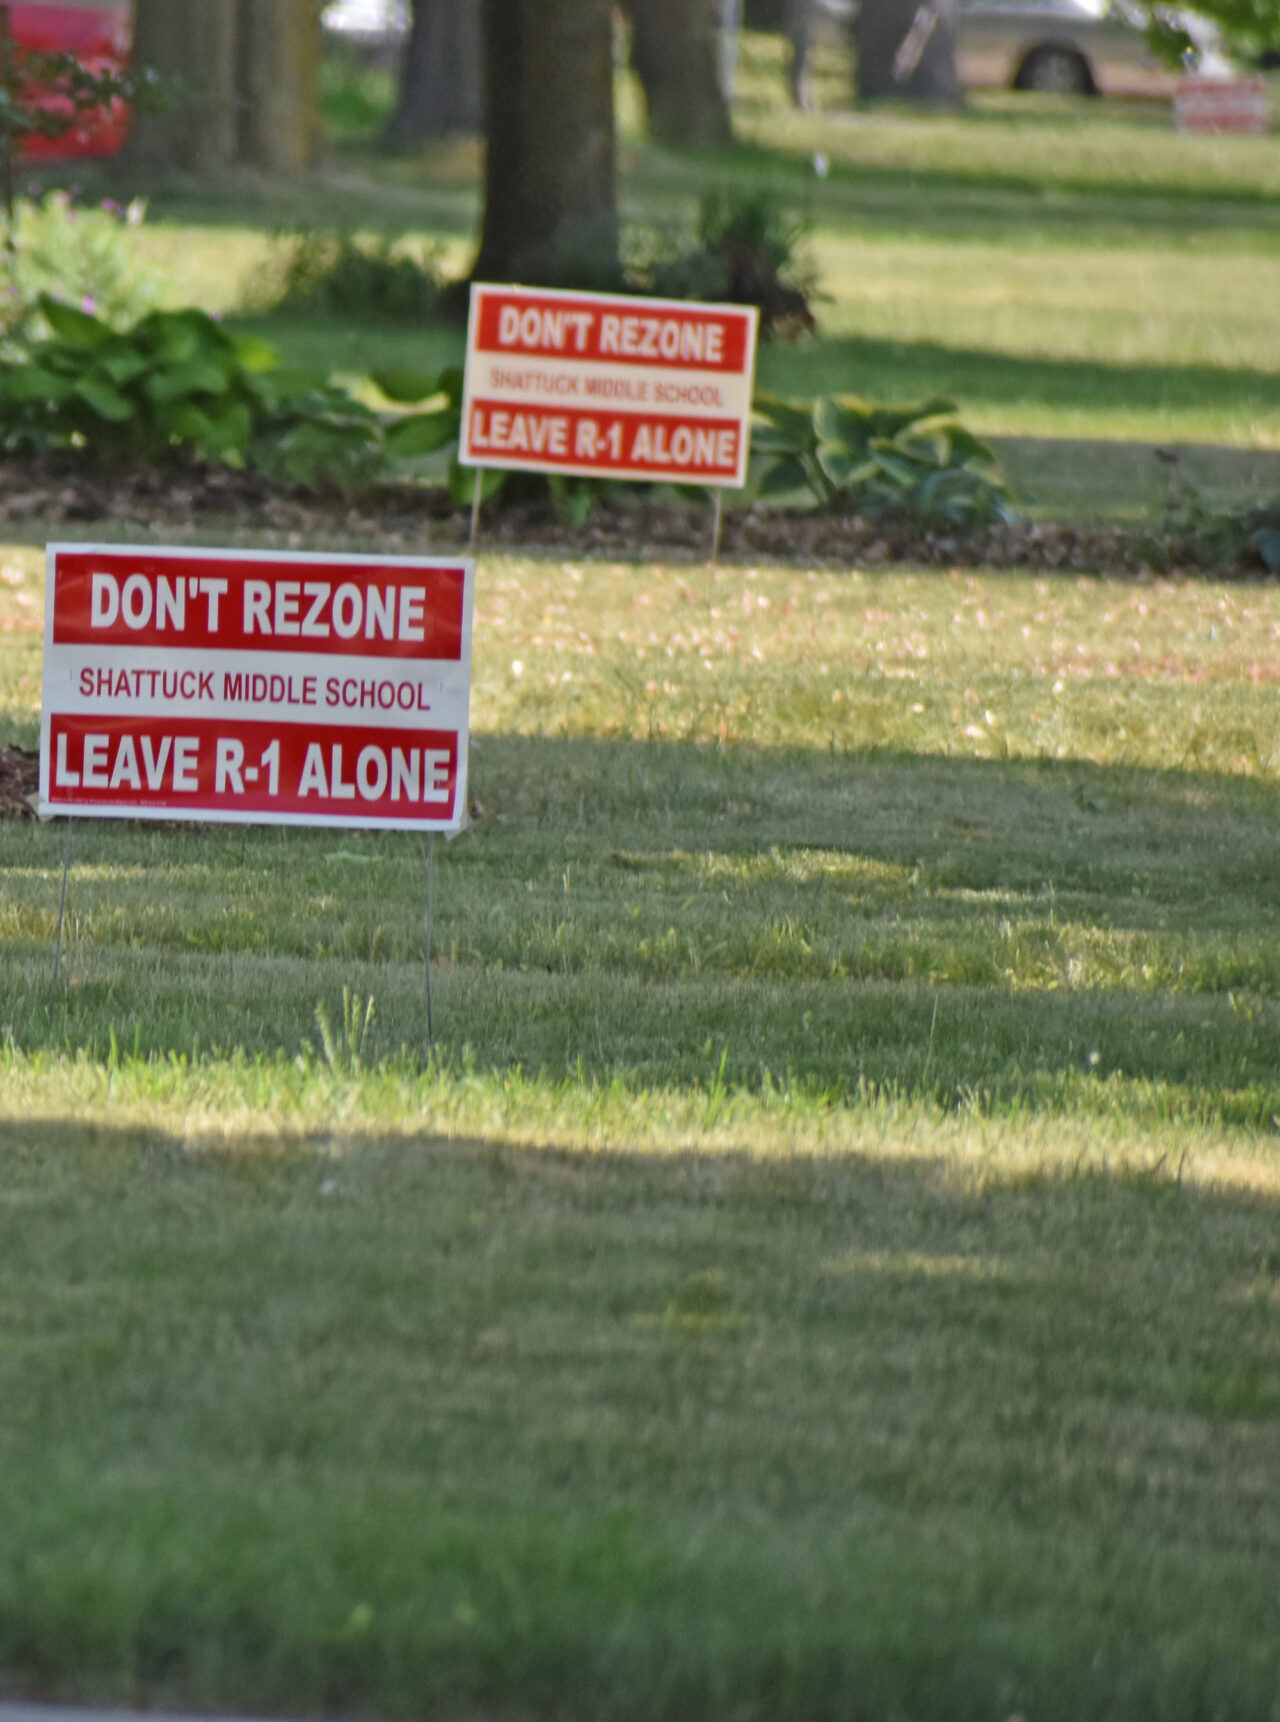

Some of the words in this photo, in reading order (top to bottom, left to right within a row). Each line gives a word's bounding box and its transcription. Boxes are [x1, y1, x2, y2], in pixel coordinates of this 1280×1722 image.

[498, 305, 593, 351] DON'T
[600, 315, 725, 362] REZONE
[489, 367, 578, 394] SHATTUCK
[584, 377, 647, 401] MIDDLE
[654, 383, 723, 407] SCHOOL
[472, 410, 568, 454] LEAVE
[576, 419, 622, 459] R-1
[630, 424, 735, 467] ALONE
[91, 573, 228, 632] DON'T
[243, 579, 426, 642] REZONE
[80, 668, 214, 699] SHATTUCK
[224, 673, 317, 704] MIDDLE
[326, 678, 431, 711] SCHOOL
[56, 732, 199, 792] LEAVE
[215, 738, 279, 796] R-1
[298, 742, 450, 803] ALONE
